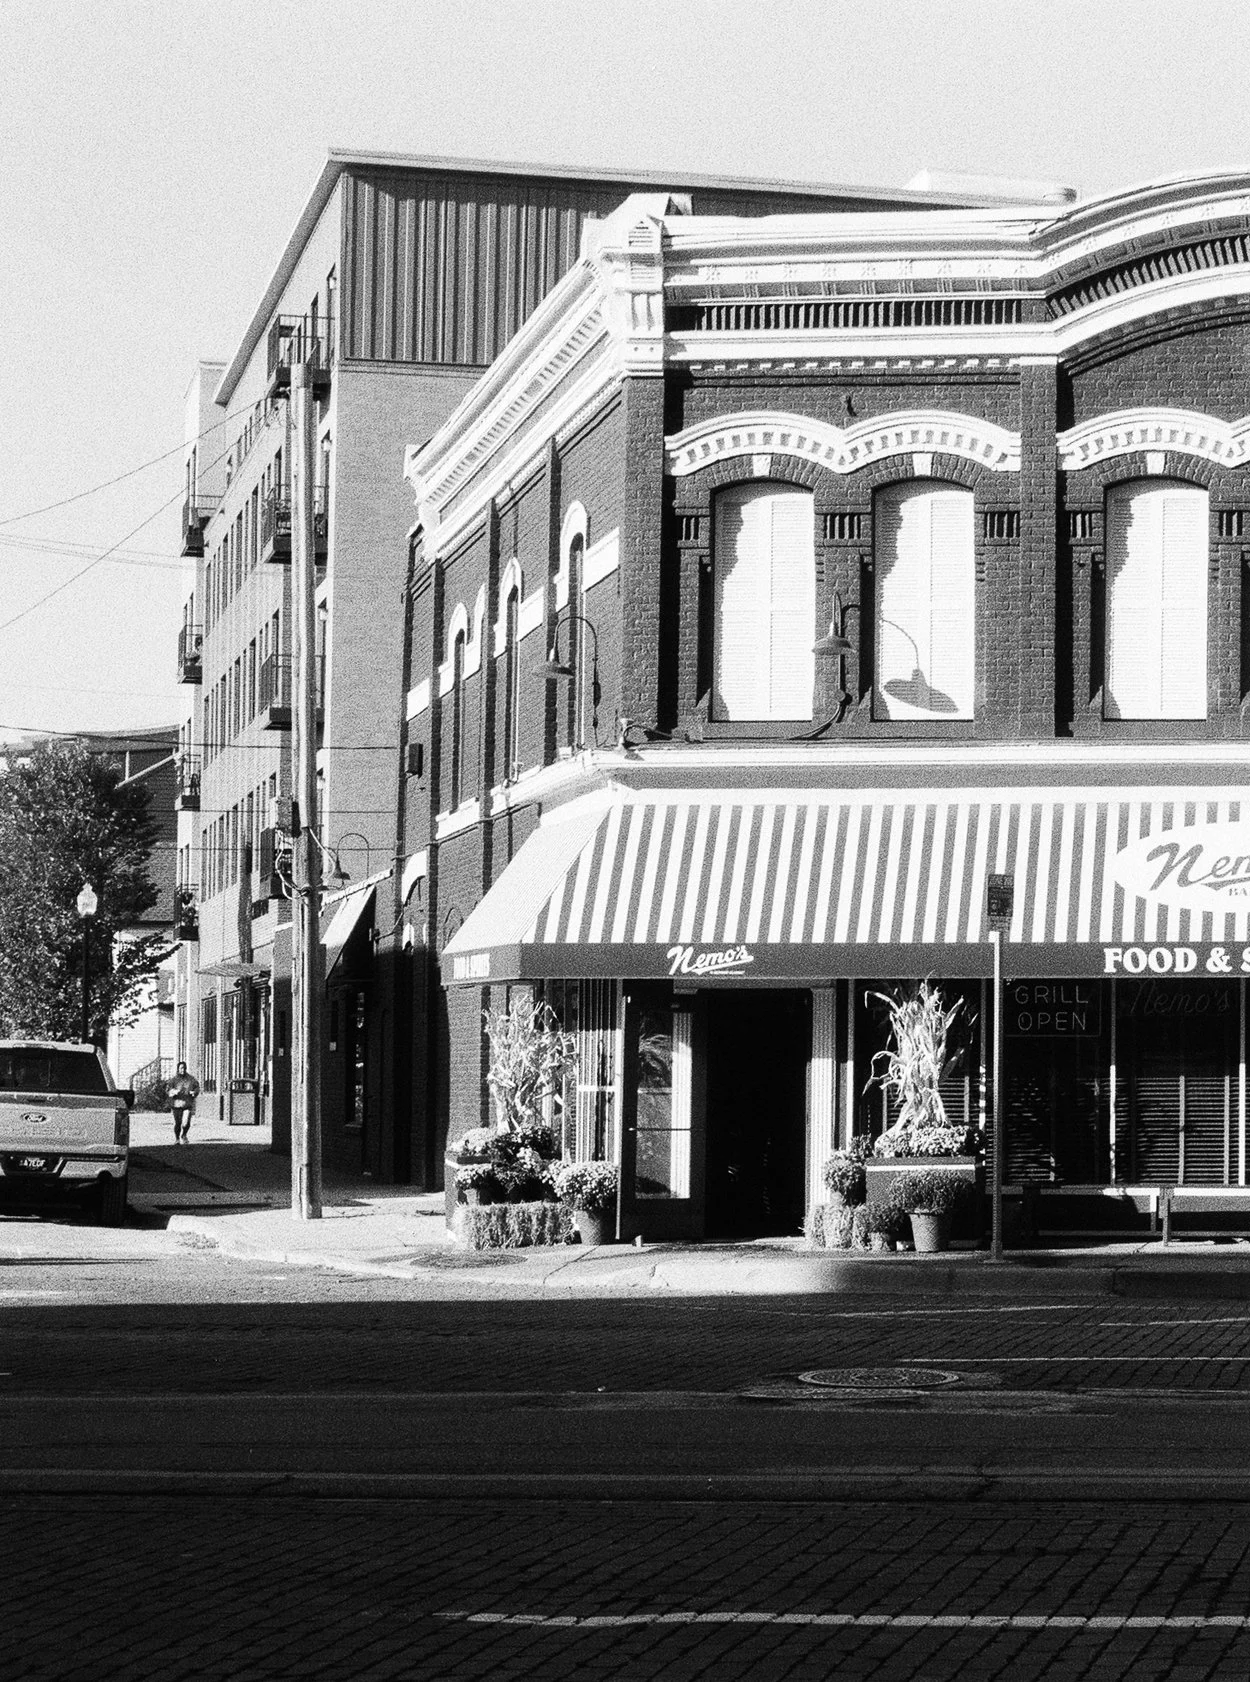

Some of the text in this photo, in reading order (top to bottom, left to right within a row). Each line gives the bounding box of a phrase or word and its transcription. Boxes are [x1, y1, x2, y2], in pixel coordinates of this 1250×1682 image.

[666, 944, 755, 976] Nemo's
[1103, 946, 1198, 974] FOOD
[1205, 947, 1233, 974] &
[1014, 984, 1089, 1005] GRILL
[1126, 978, 1230, 1017] Nemo's
[1017, 1011, 1087, 1031] OPEN
